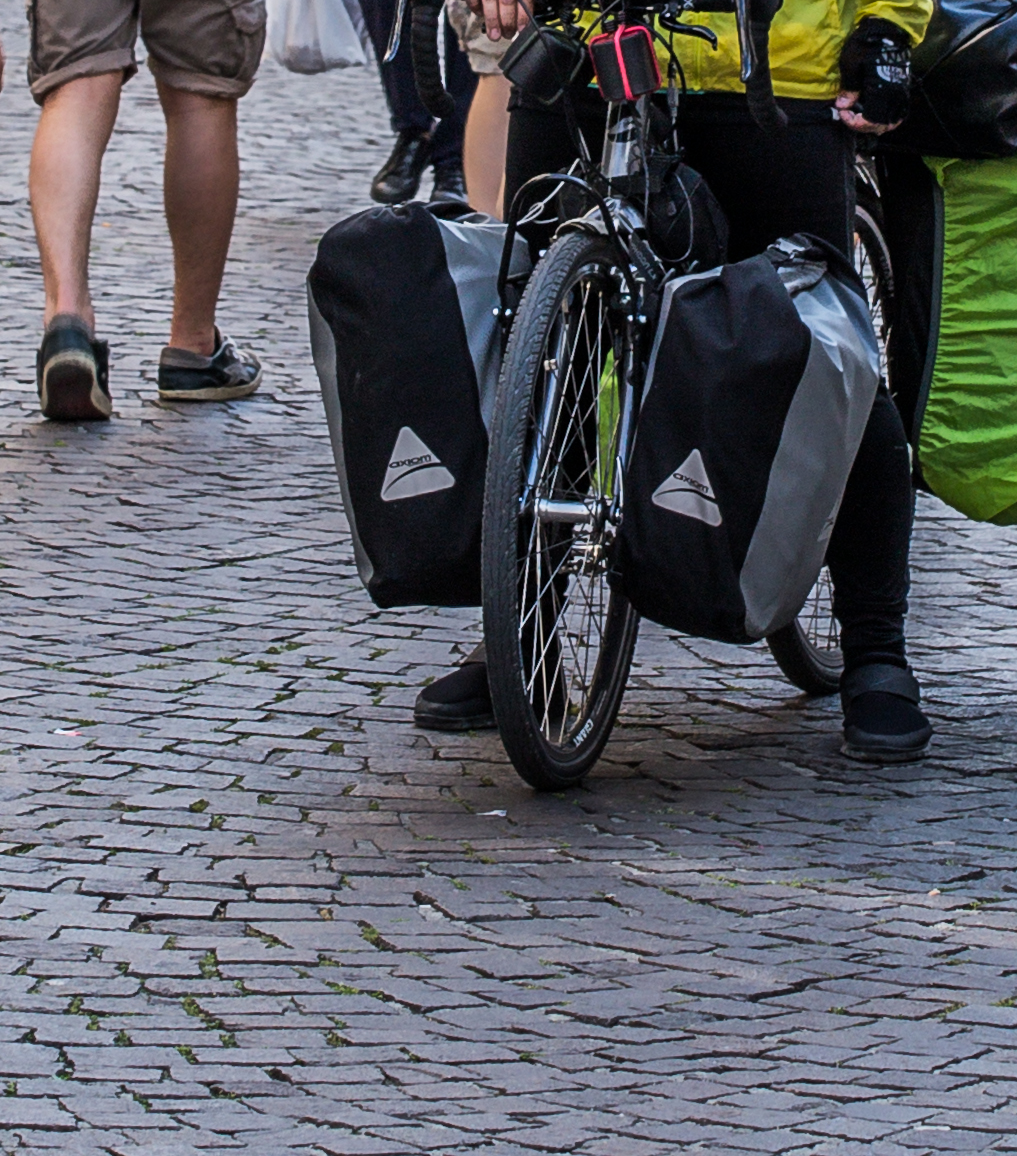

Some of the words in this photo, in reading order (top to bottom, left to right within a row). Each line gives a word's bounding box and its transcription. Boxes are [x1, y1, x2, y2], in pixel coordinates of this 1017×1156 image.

[388, 453, 432, 469] axiom
[672, 472, 709, 494] axiom
[572, 718, 594, 748] GIANT
